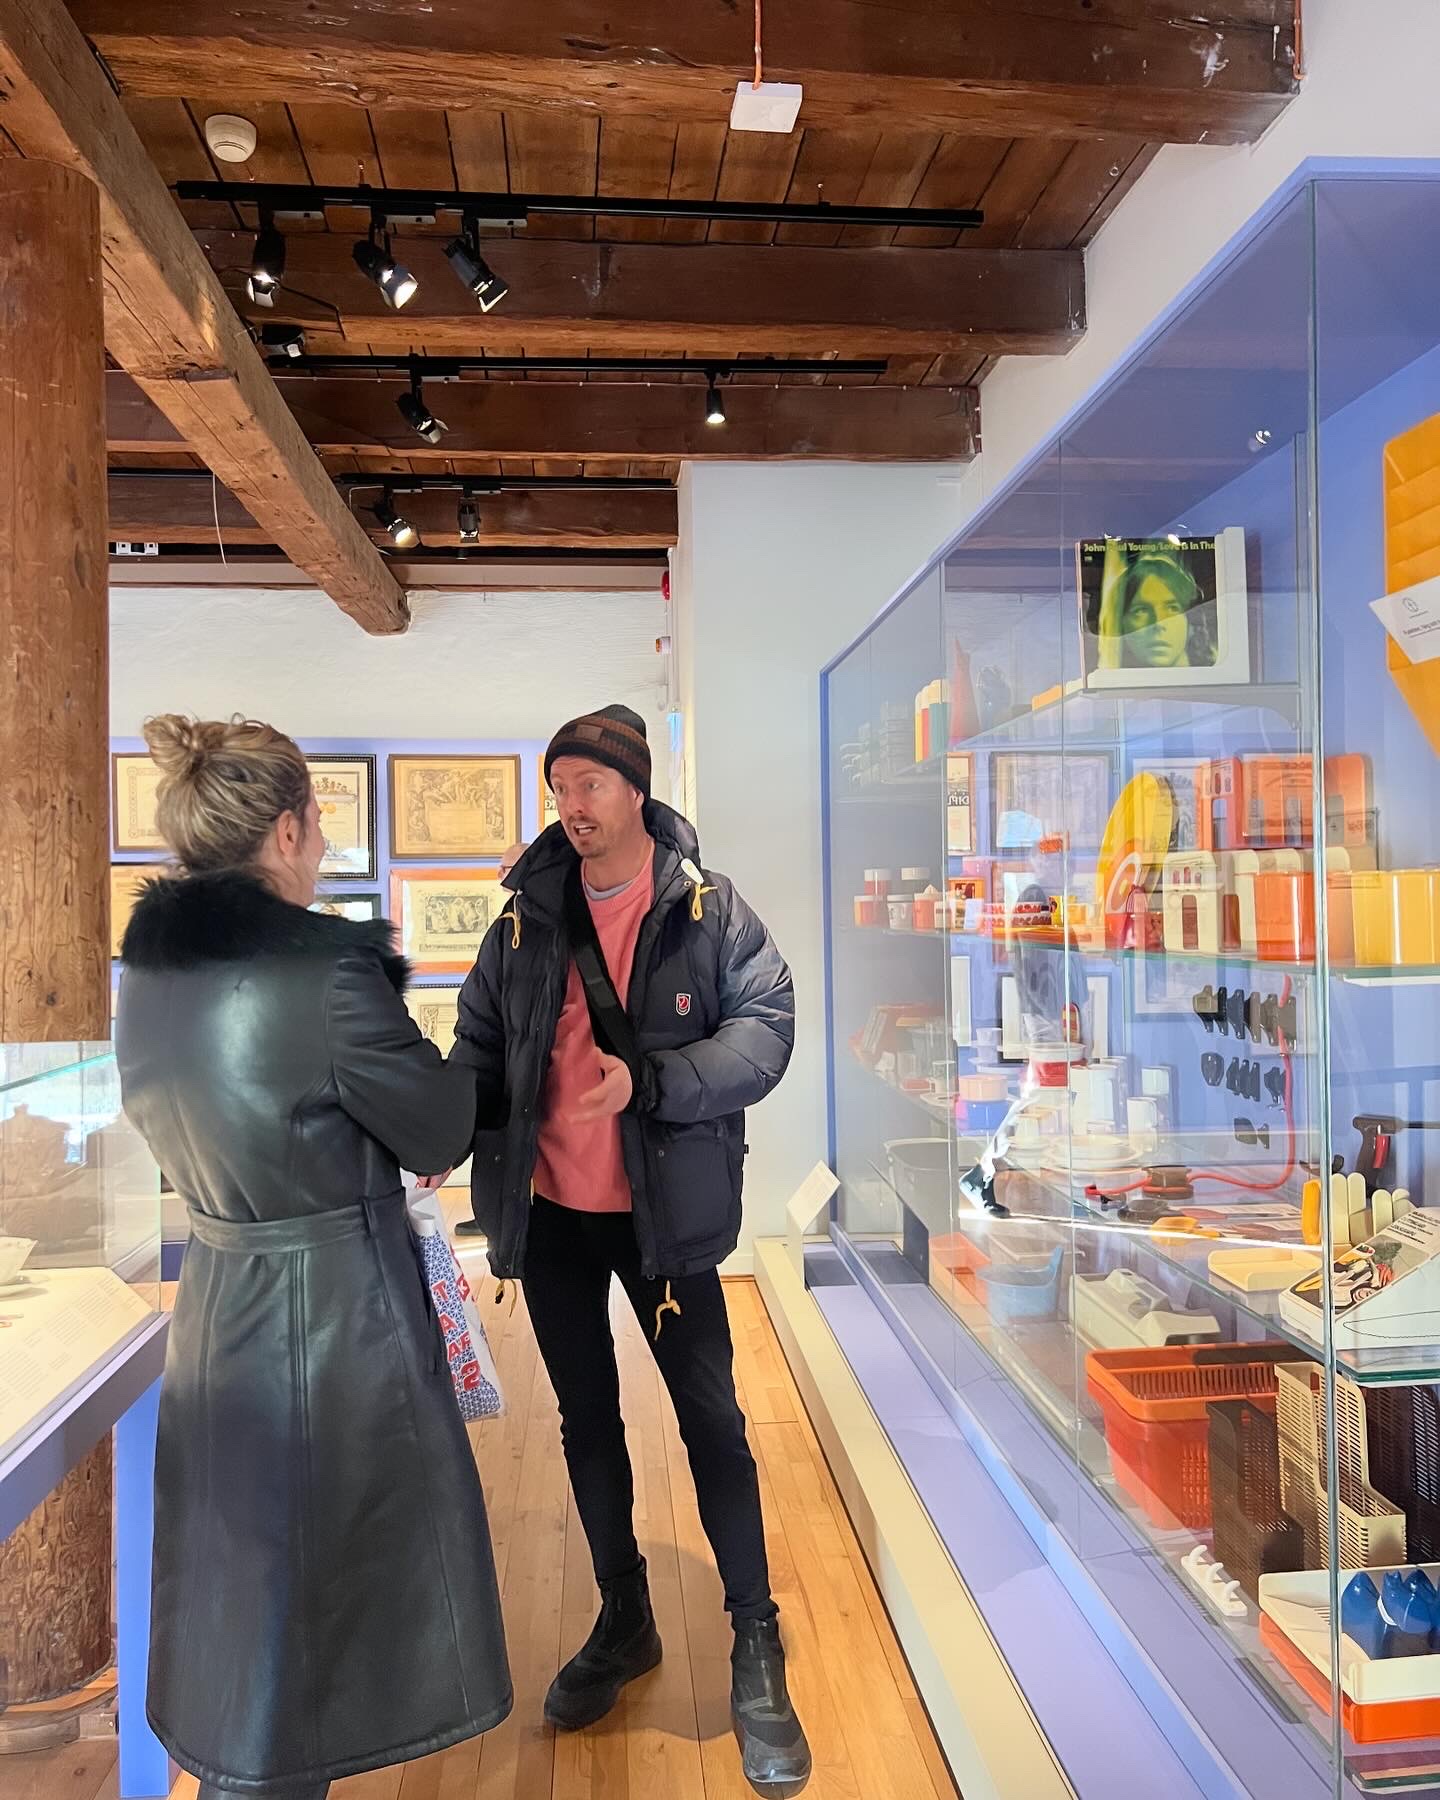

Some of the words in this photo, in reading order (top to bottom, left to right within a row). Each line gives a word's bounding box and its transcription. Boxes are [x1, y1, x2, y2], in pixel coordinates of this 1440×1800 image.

[1083, 543, 1106, 552] John
[1107, 542, 1127, 551] Pul
[1190, 541, 1199, 550] In
